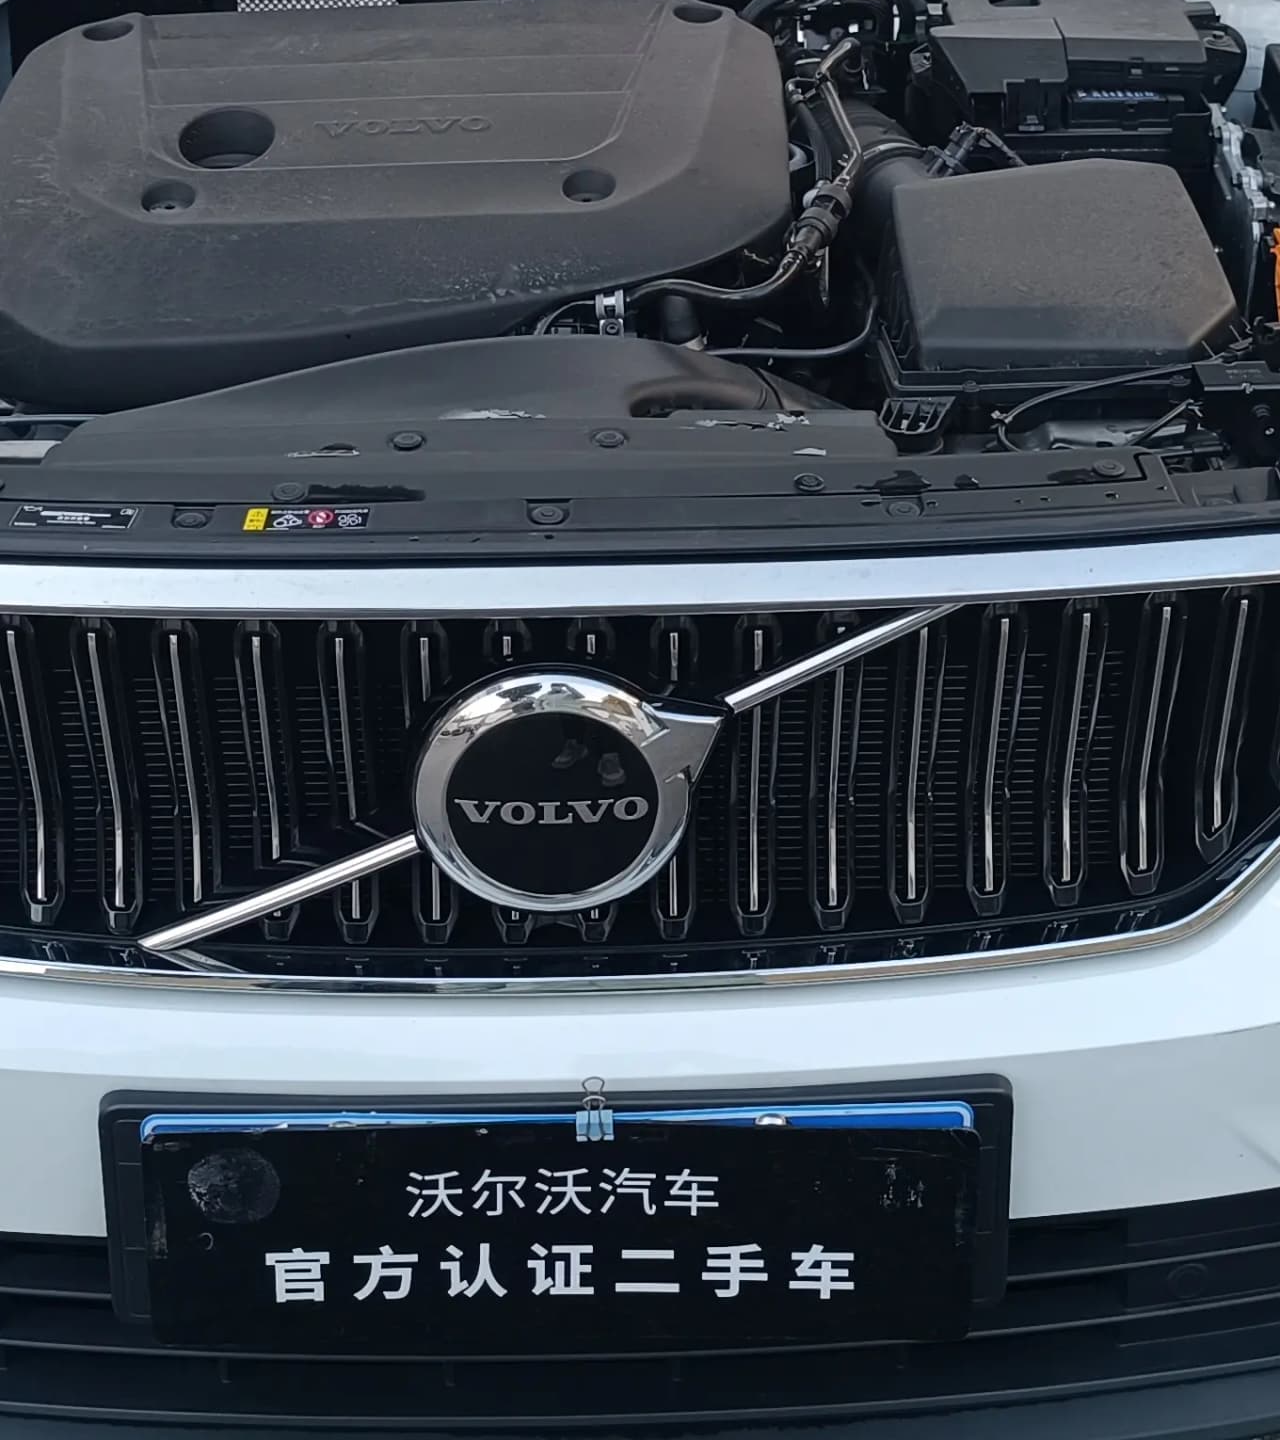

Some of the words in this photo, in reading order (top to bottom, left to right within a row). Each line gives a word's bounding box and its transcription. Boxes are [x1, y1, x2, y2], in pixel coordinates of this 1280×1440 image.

[312, 115, 495, 138] VOLVO
[453, 796, 650, 826] VOLVO
[406, 1168, 718, 1217] 沃尔沃汽车
[266, 1243, 854, 1302] 官方认证二手车
